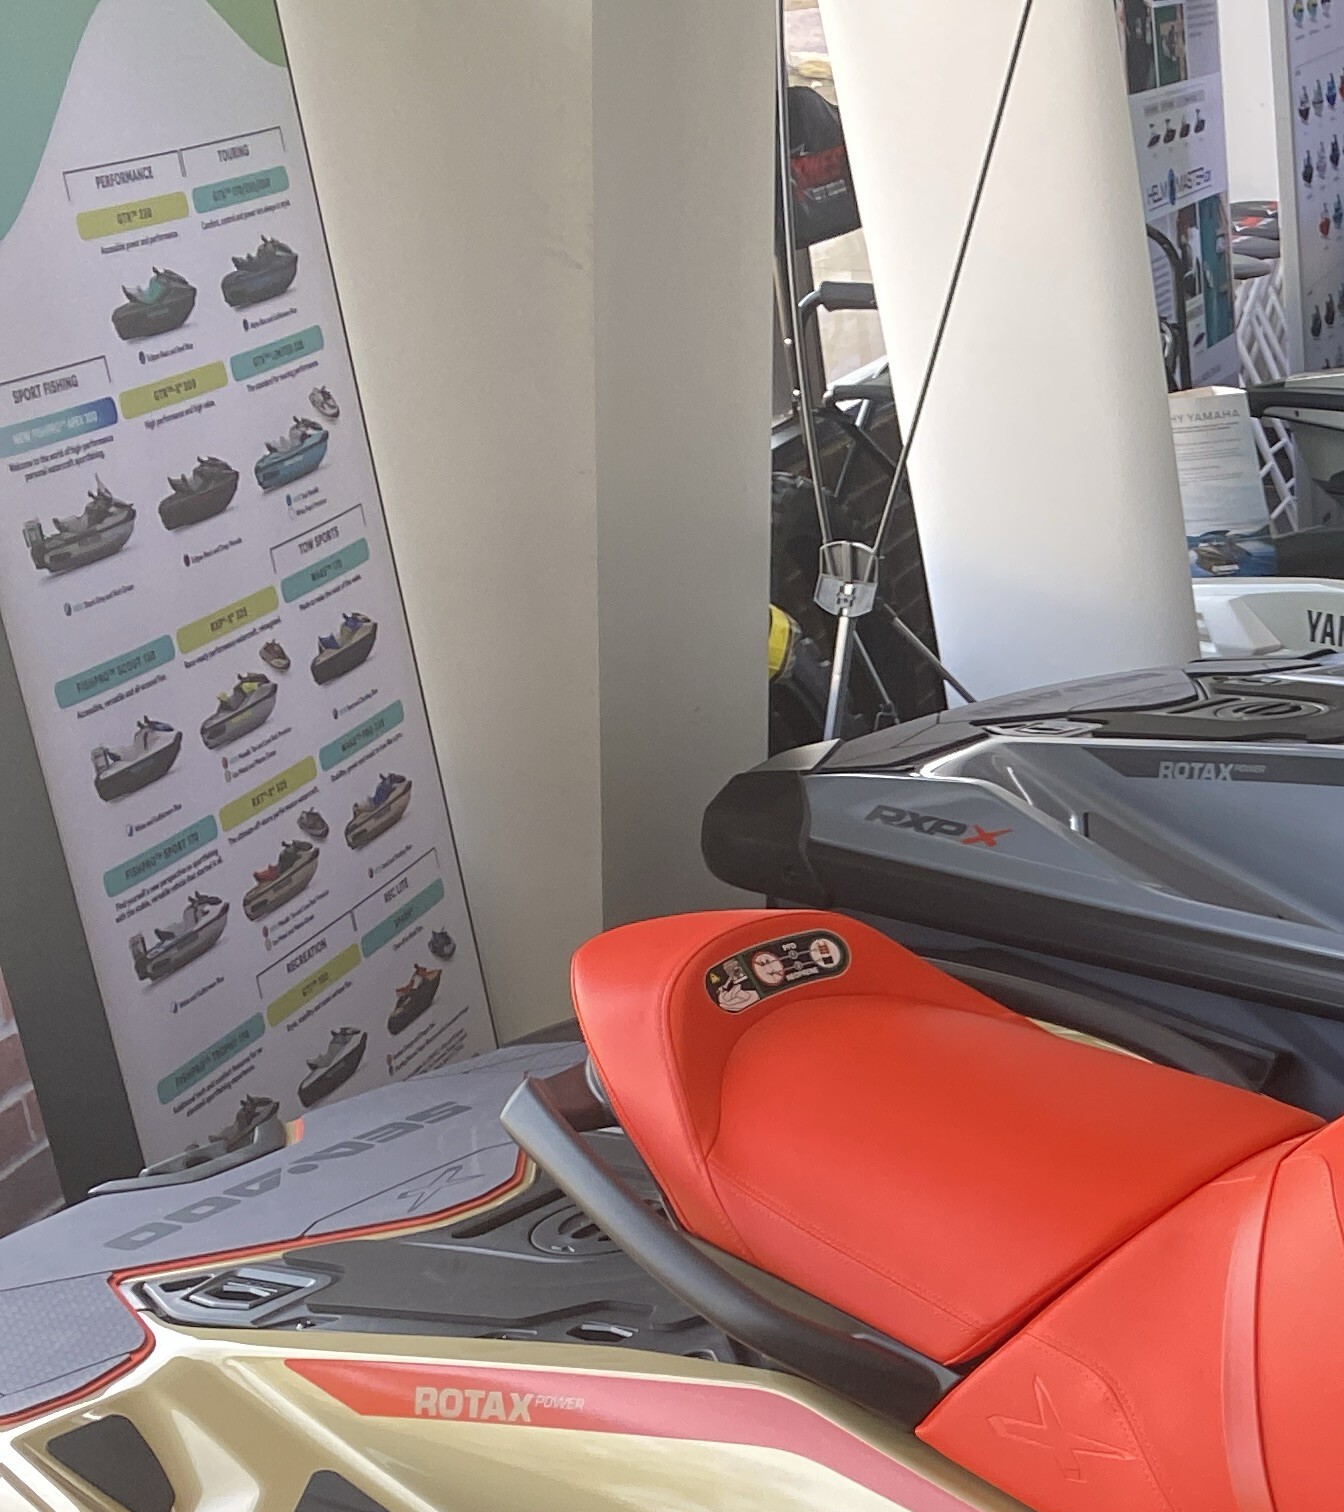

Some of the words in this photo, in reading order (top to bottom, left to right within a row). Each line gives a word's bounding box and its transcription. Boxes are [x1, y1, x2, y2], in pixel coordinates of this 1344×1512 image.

[95, 165, 154, 189] PERFORMANCE
[12, 384, 42, 405] SPORT
[1186, 408, 1241, 422] YAMAHA
[1158, 761, 1234, 781] ROTAX
[414, 1386, 535, 1423] ROTAX
[534, 1394, 586, 1411] POWER
